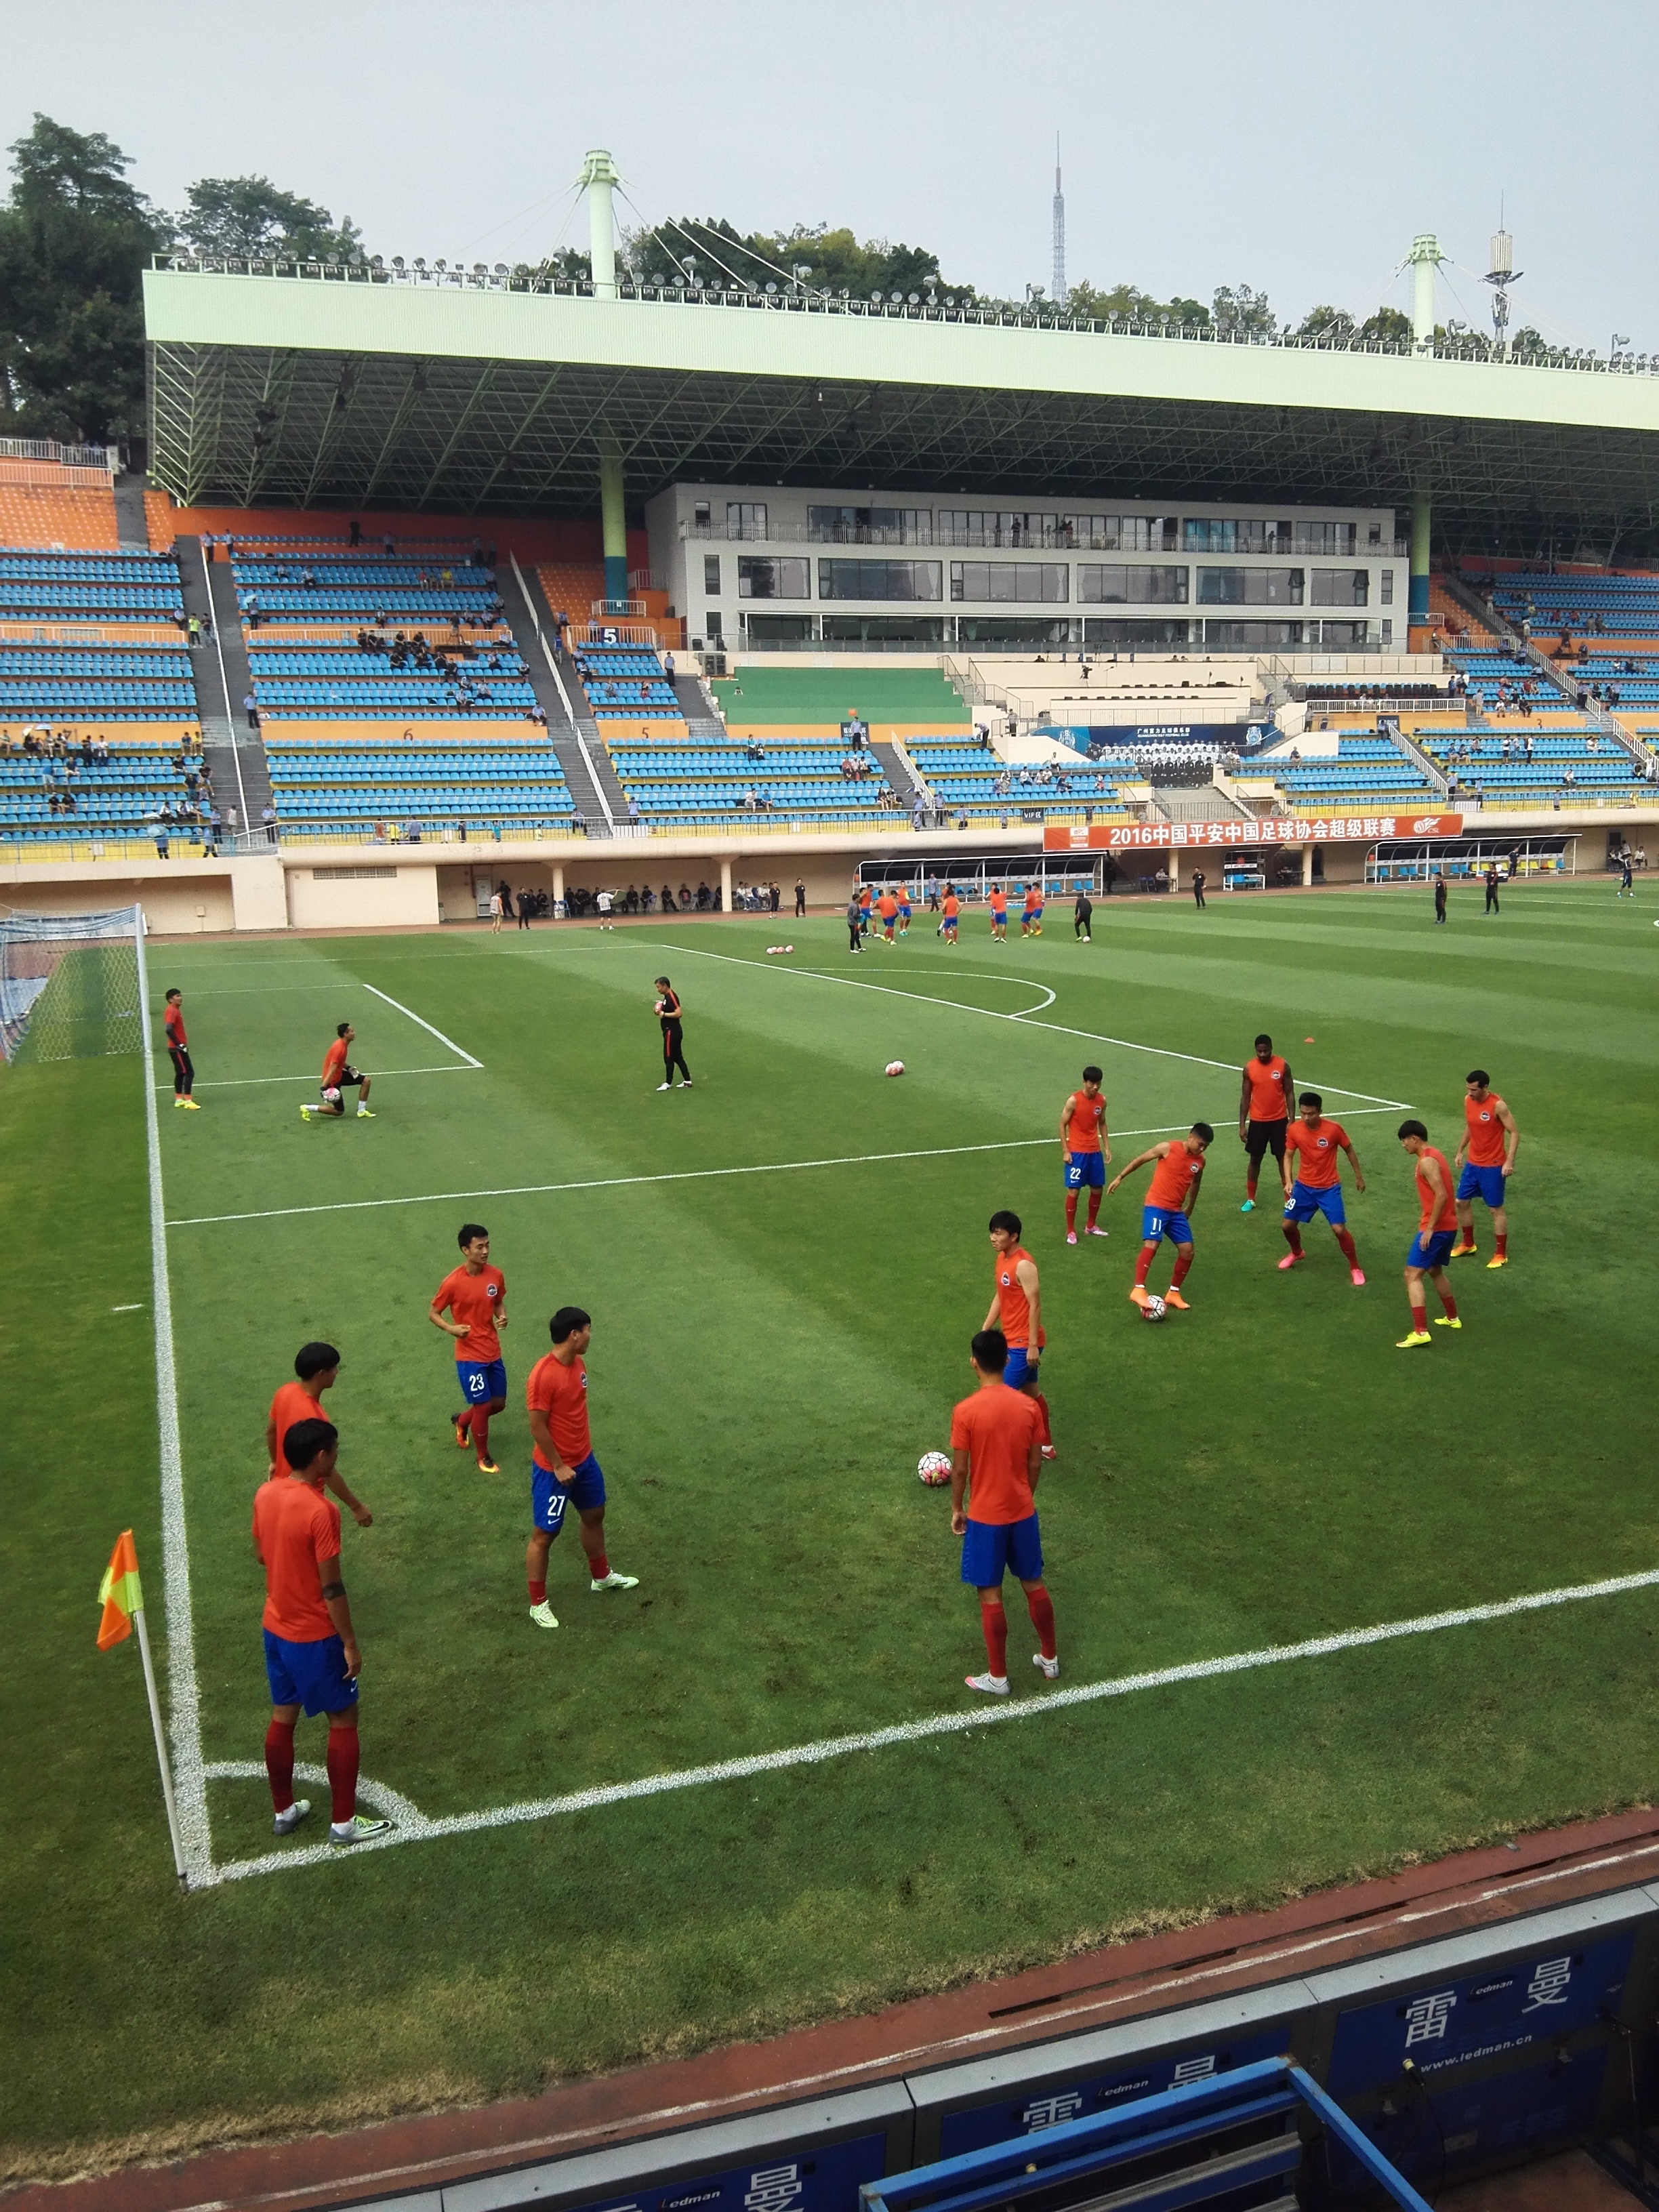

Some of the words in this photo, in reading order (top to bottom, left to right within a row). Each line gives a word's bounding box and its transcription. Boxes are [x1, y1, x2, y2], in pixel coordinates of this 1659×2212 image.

[603, 628, 617, 644] 5
[1110, 818, 1396, 845] 2016中国平安中国足球协会超级联赛
[1070, 1167, 1081, 1179] 22
[1152, 1217, 1162, 1232] 11
[469, 1373, 485, 1392] 23
[547, 1495, 565, 1517] 27
[1405, 1990, 1456, 2048] 雷
[1521, 1957, 1571, 2013] 曼
[1420, 2034, 1532, 2073] www.ledman.cn
